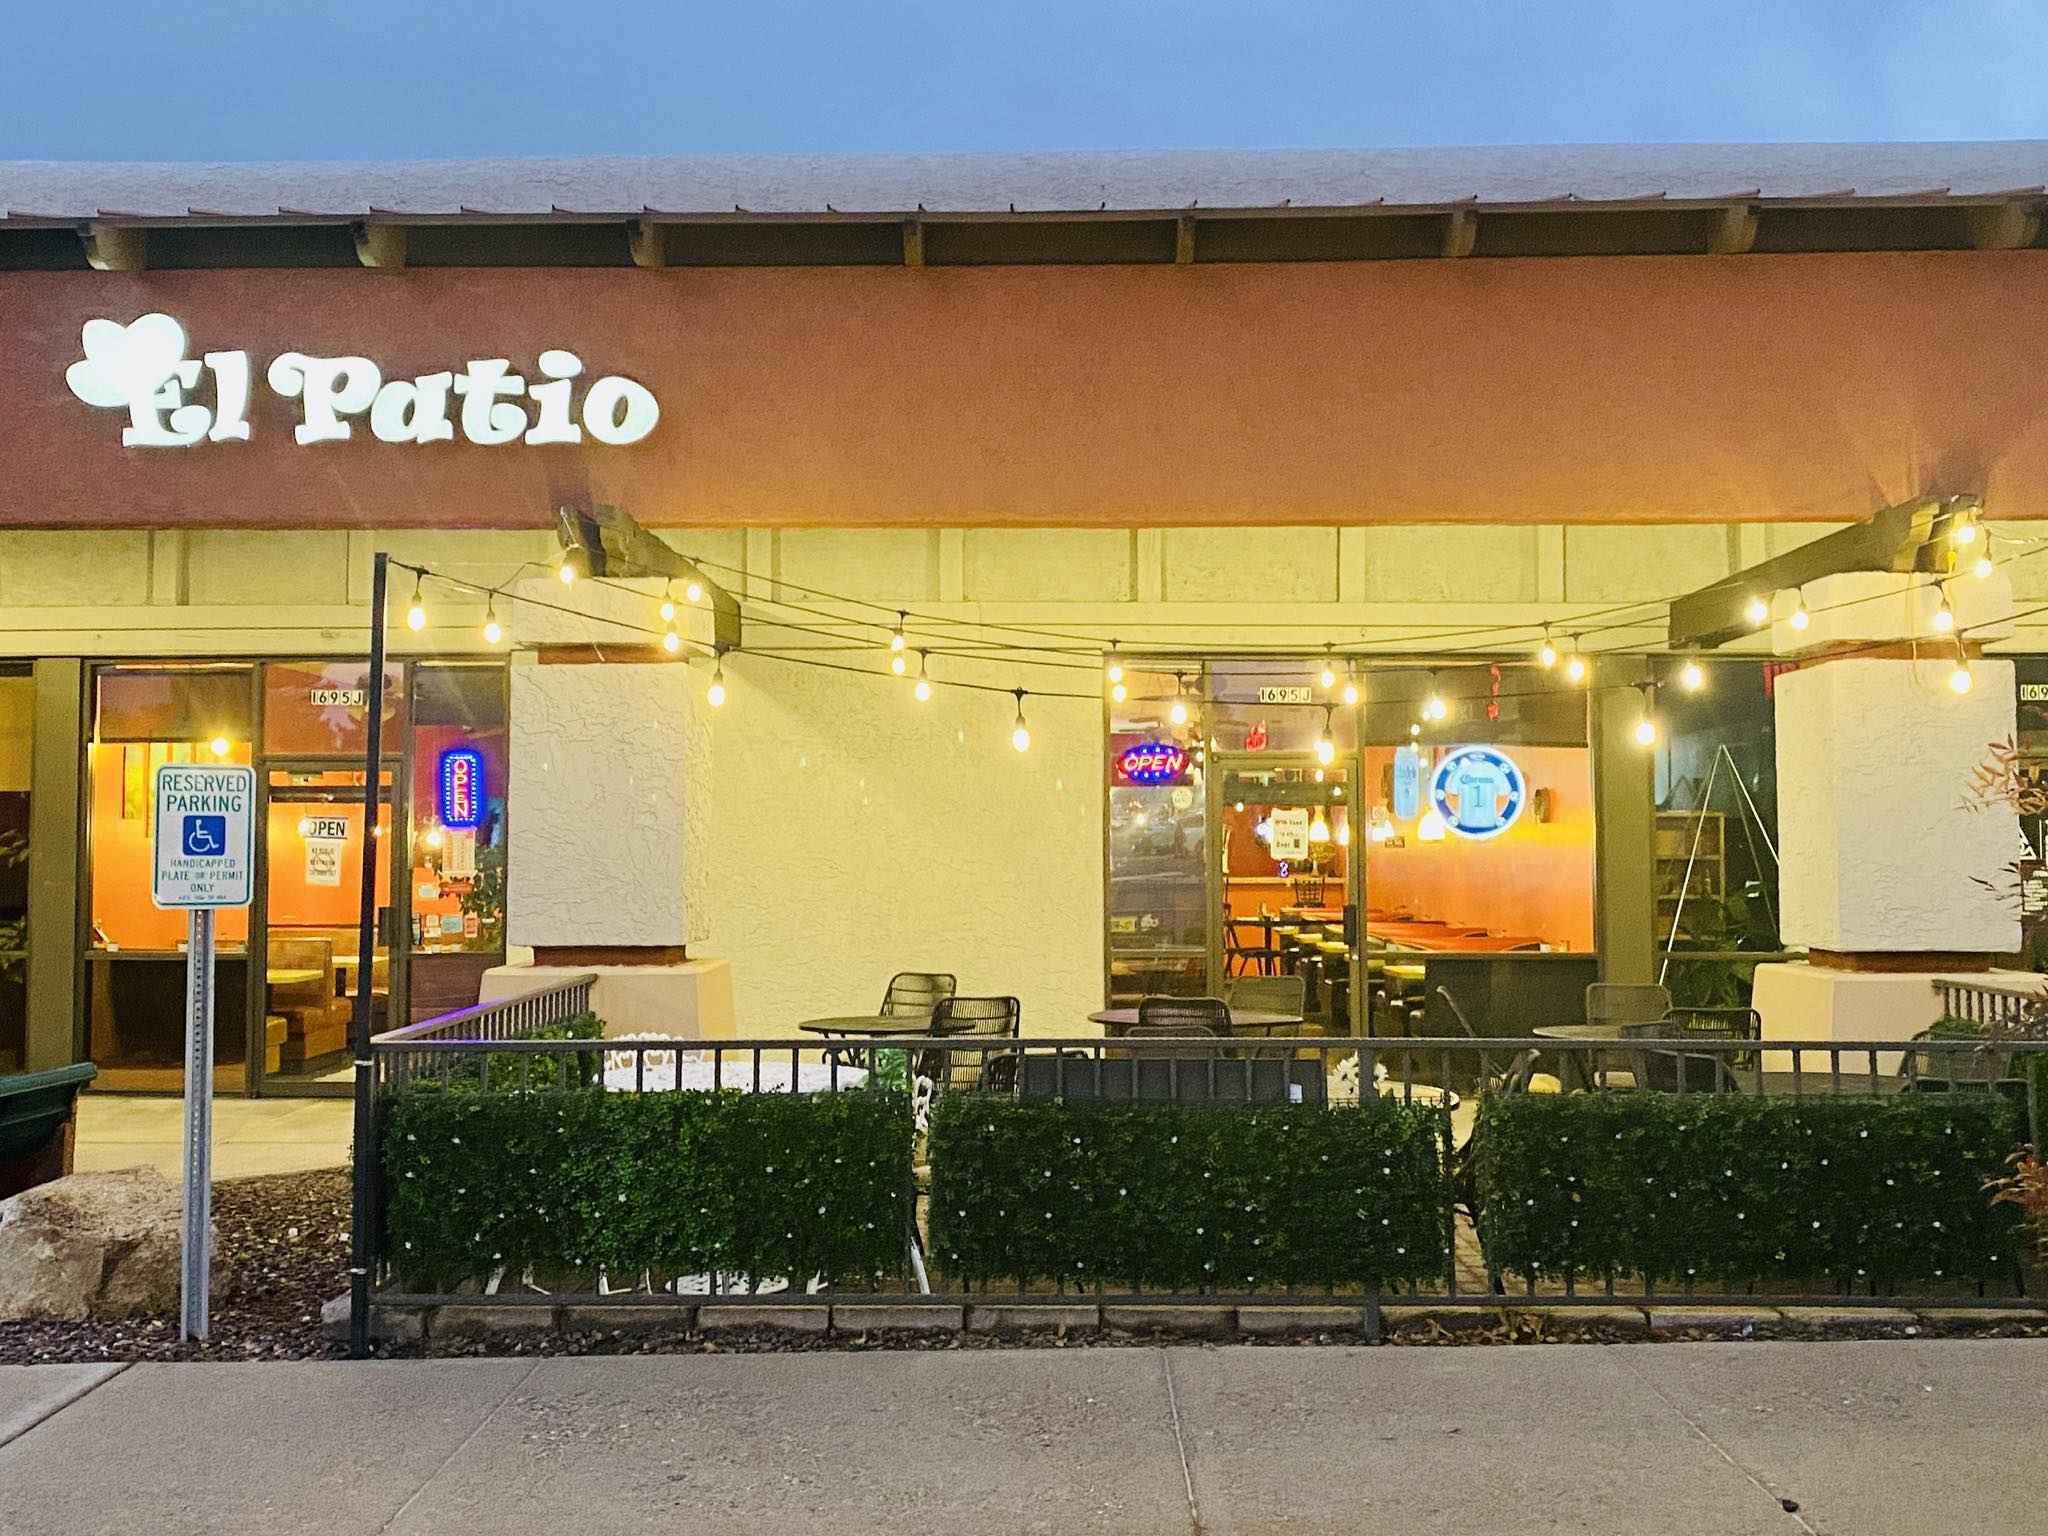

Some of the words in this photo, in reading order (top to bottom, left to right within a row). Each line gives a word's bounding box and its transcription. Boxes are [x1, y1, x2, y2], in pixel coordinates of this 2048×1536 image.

[122, 349, 250, 447] El
[267, 350, 660, 446] Patio
[311, 691, 362, 705] 1695J
[1260, 688, 1310, 702] 1695J
[1123, 753, 1183, 771] OPEN
[162, 774, 247, 793] RESERVED
[1459, 774, 1495, 785] Corona
[453, 759, 469, 818] OPEN
[166, 795, 242, 813] PARKING
[170, 858, 236, 869] HANDICAPPED
[161, 870, 190, 881] PLATE
[210, 870, 244, 881] PERMIT
[190, 883, 214, 893] ONLY
